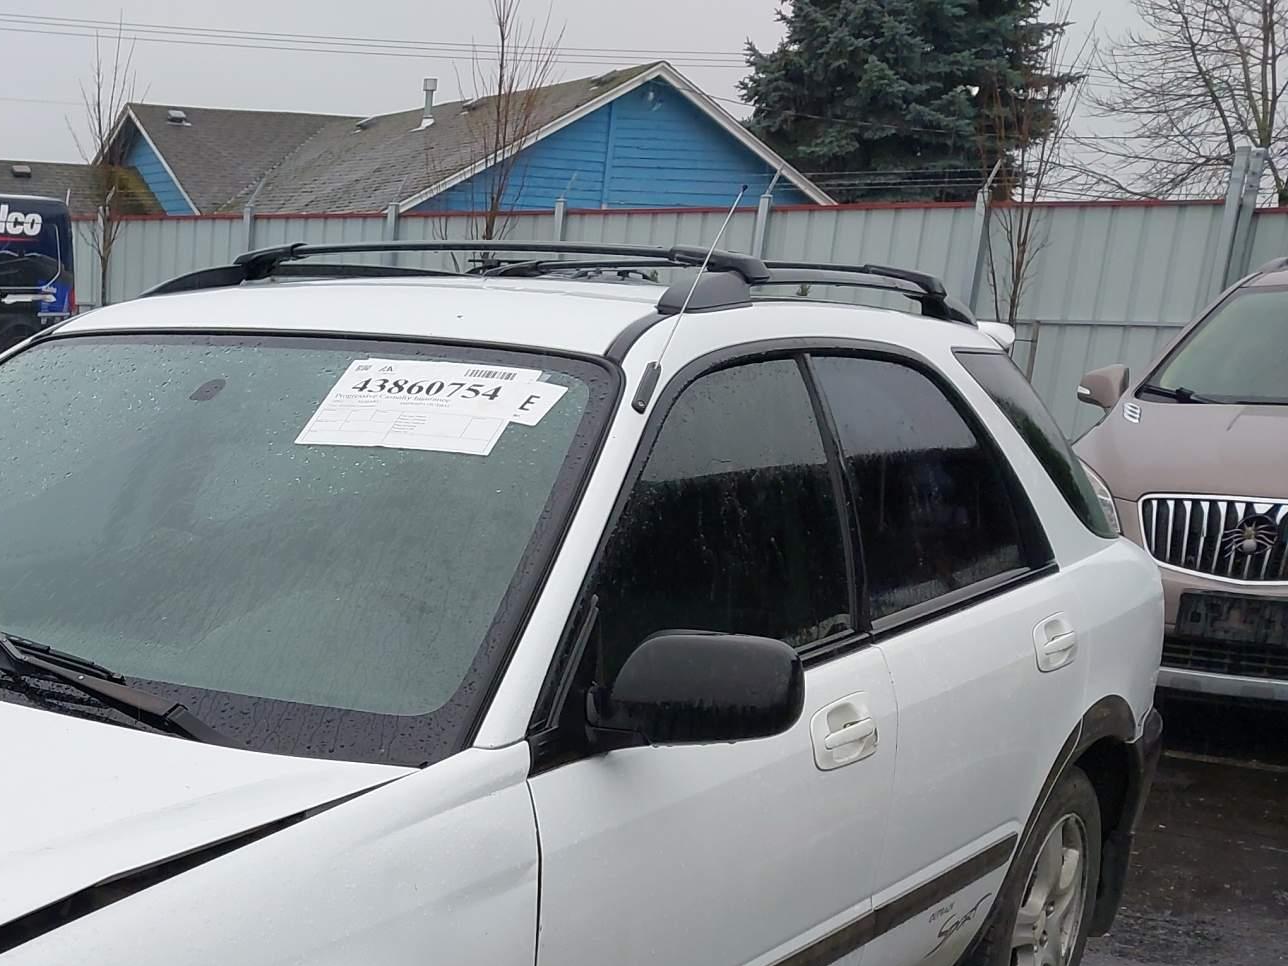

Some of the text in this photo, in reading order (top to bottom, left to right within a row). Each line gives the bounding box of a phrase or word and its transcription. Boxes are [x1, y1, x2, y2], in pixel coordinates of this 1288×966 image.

[335, 392, 378, 400] Progressive
[352, 377, 502, 401] 43860754
[518, 395, 541, 411] E
